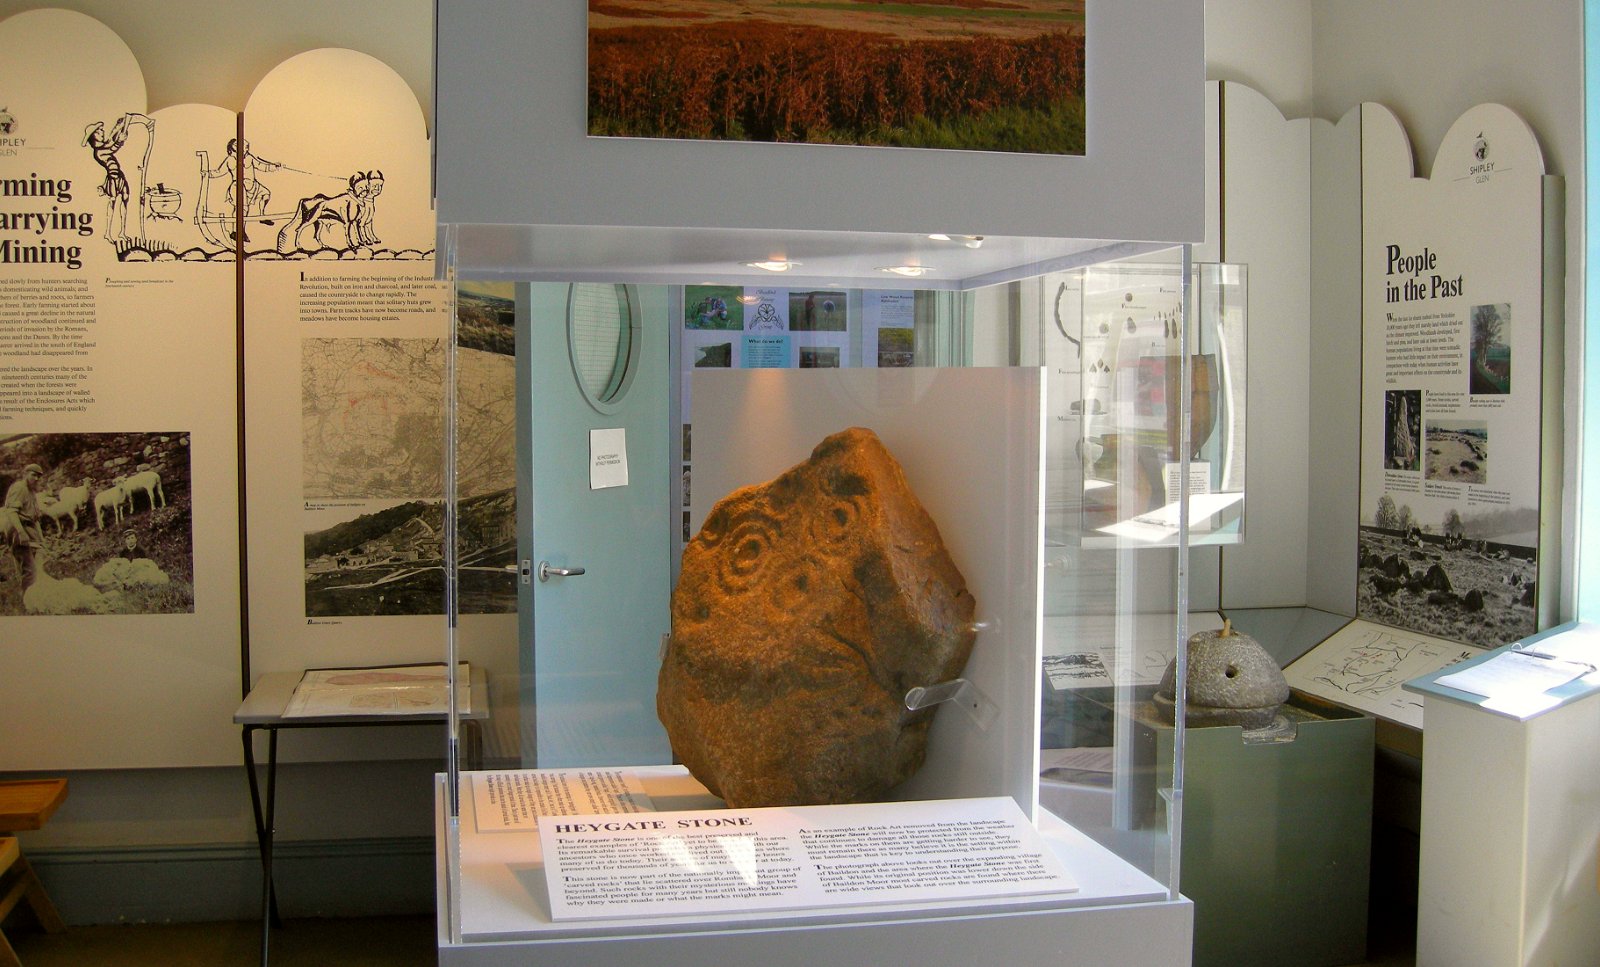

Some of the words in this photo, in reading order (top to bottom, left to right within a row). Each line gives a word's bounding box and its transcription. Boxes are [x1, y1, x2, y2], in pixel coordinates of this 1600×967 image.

[1470, 162, 1494, 175] SHIPLEY
[1476, 175, 1490, 184] GLEN
[0, 206, 94, 236] arrying
[1386, 244, 1436, 277] People
[1386, 281, 1400, 303] in
[1404, 278, 1426, 302] the
[1430, 274, 1464, 299] Past
[556, 821, 666, 832] HEYGATE
[678, 818, 752, 828] STONE
[918, 827, 952, 835] protected
[834, 862, 879, 870] photograph
